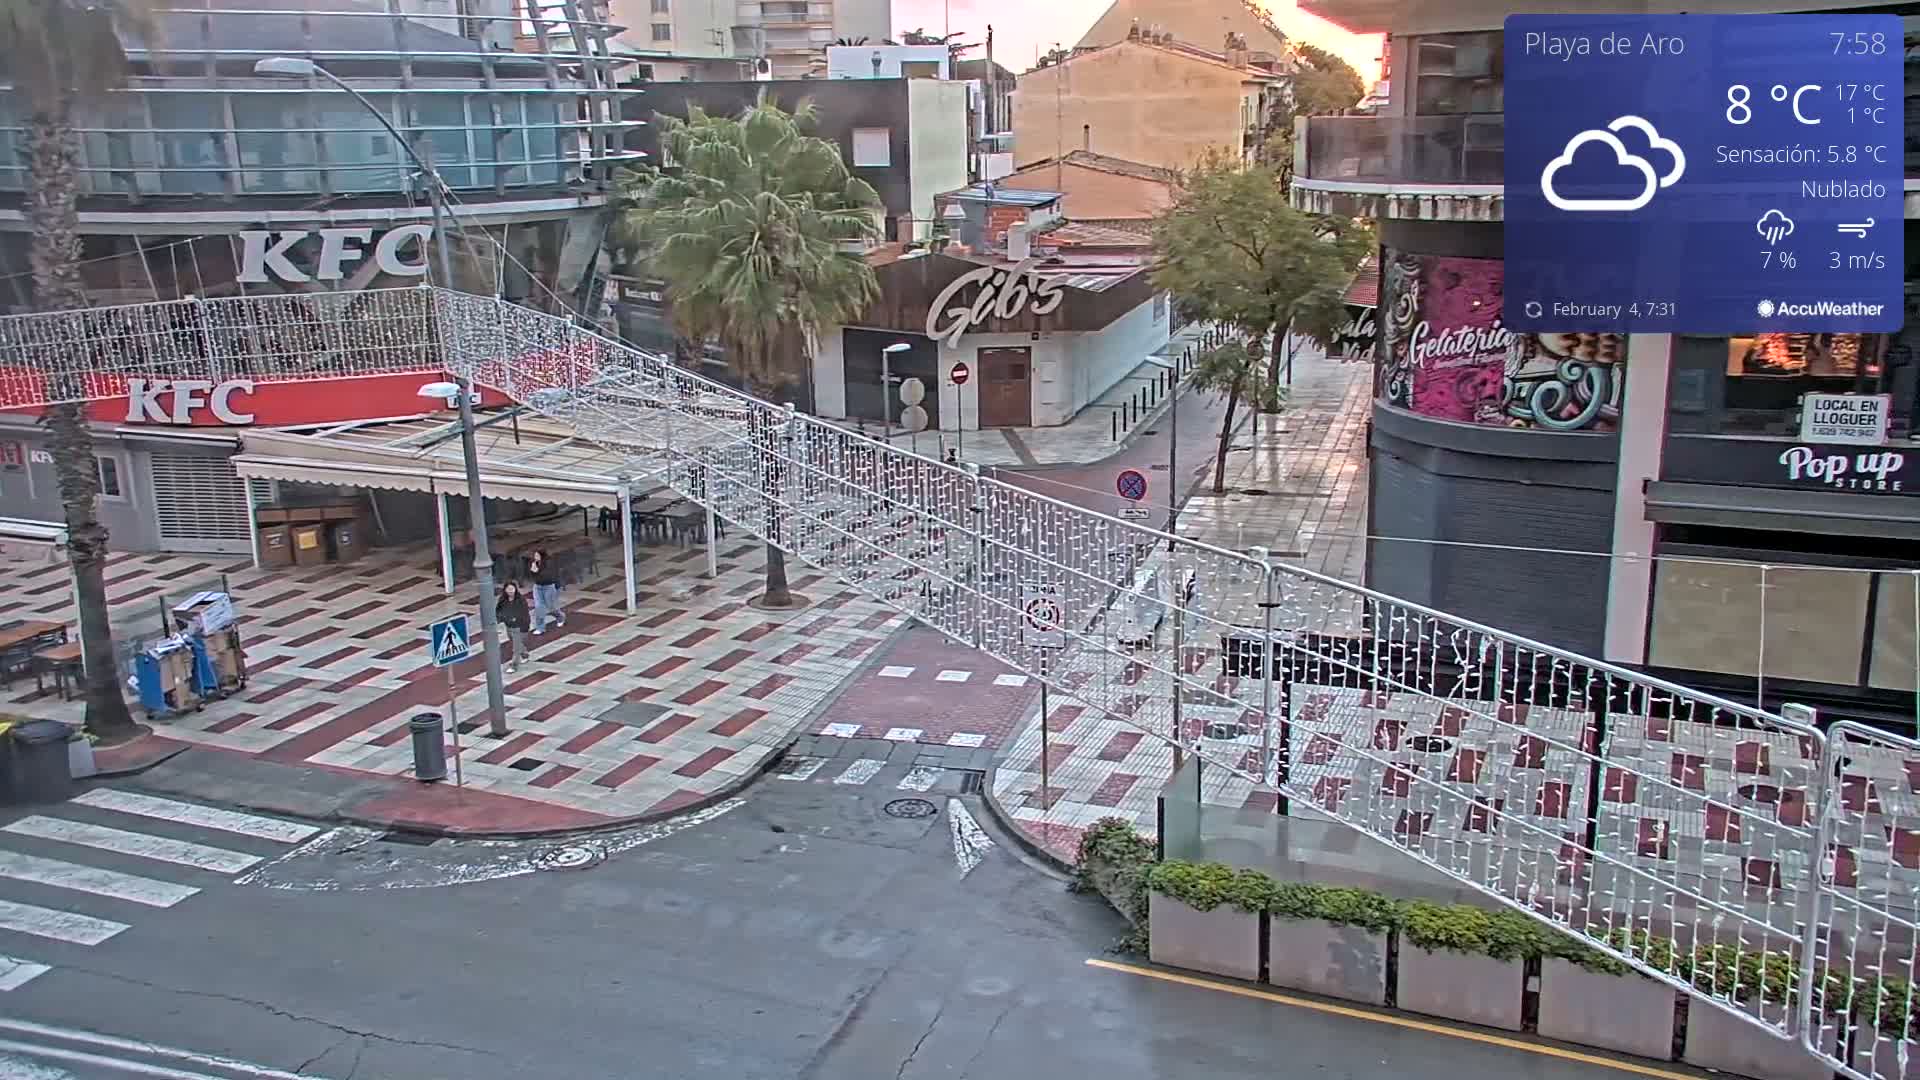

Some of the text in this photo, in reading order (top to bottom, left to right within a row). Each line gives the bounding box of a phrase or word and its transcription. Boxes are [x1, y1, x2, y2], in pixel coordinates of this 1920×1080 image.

[236, 224, 434, 283] KFC
[926, 257, 1069, 349] Gib's
[1409, 320, 1513, 369] Gelateria
[125, 378, 255, 424] KFC
[1813, 412, 1877, 426] LLOGUER
[1815, 399, 1879, 412] LOCAL EN
[1779, 446, 1905, 484] Pop up
[1835, 477, 1903, 492] STORE
